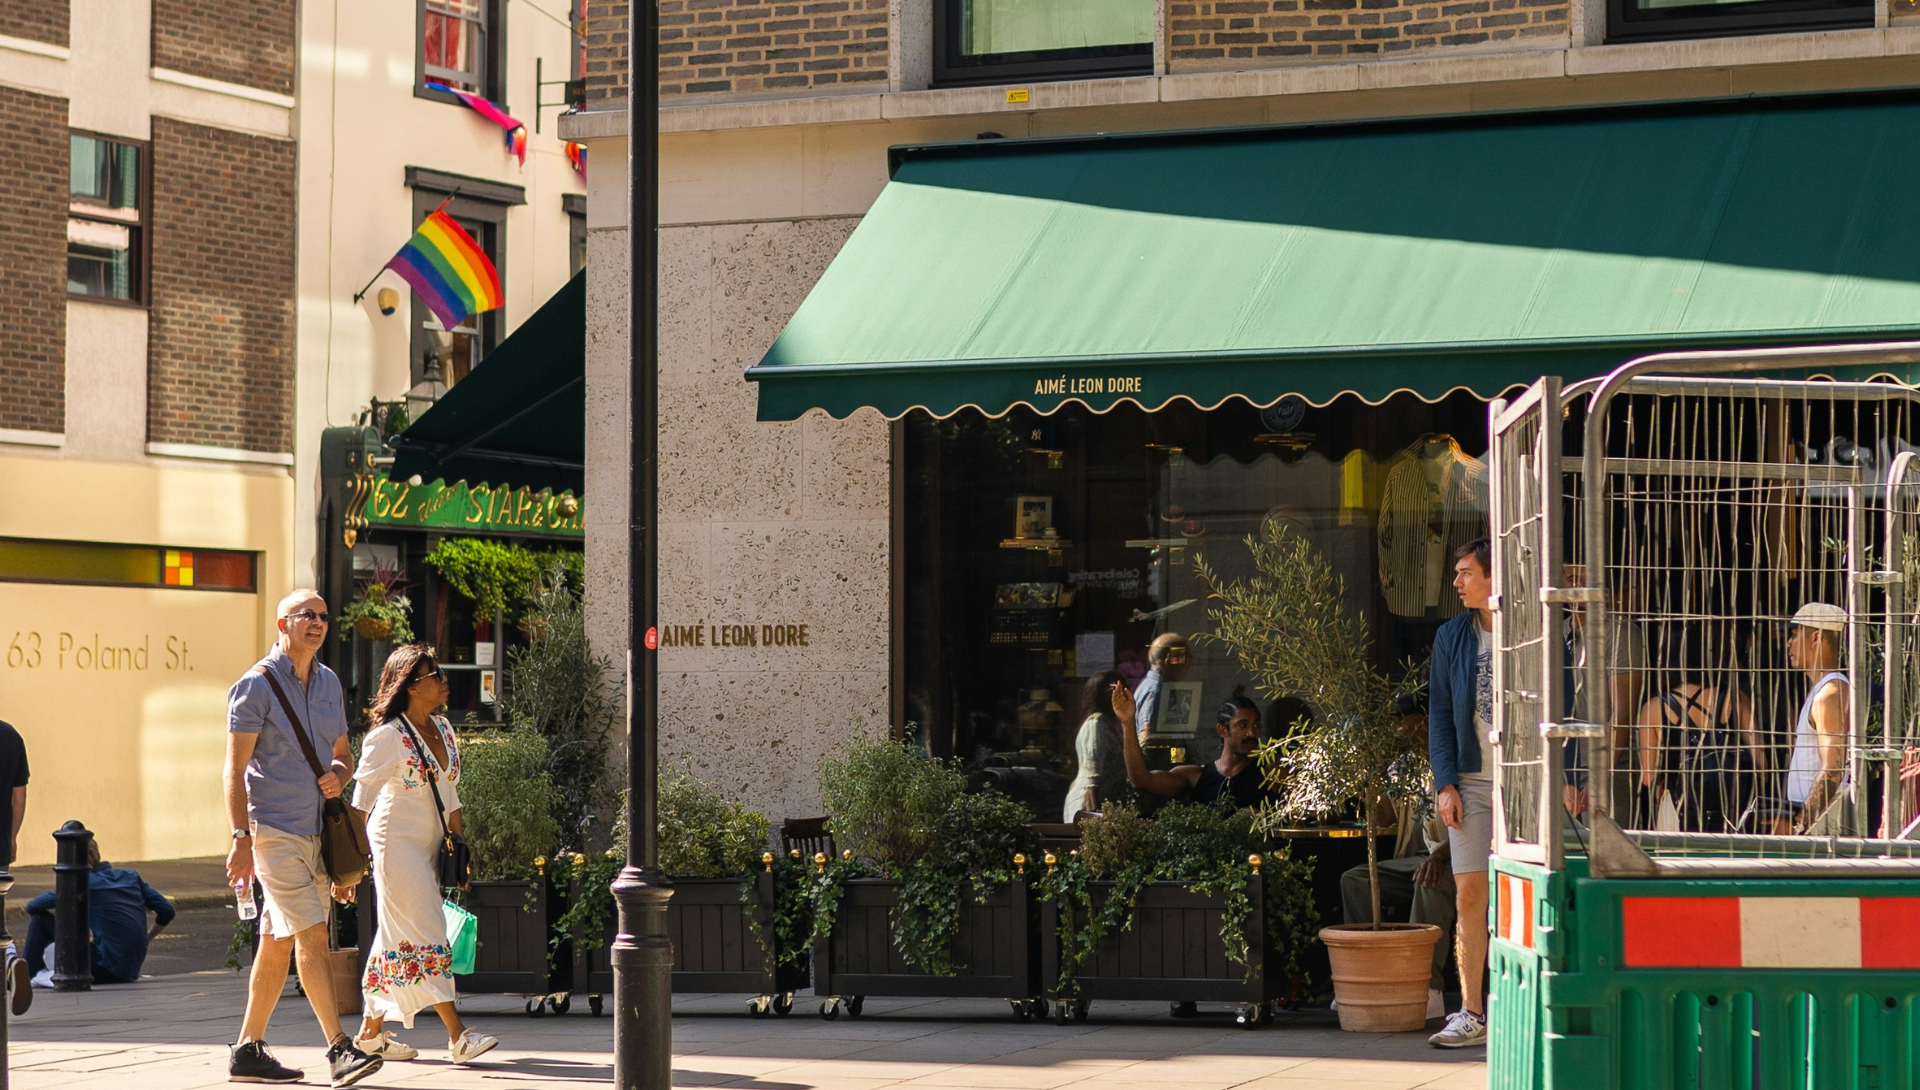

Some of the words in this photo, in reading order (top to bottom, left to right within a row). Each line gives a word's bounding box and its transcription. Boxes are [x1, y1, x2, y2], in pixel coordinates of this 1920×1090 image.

[1035, 374, 1066, 394] AIMÉ
[1070, 378, 1103, 394] LEON
[1108, 377, 1142, 393] DORE
[374, 478, 409, 519] 62
[661, 619, 704, 647] AIMÉ
[711, 625, 757, 647] LEON
[762, 624, 809, 647] DORE
[7, 631, 42, 669] 63
[59, 631, 149, 671] Poland
[165, 635, 193, 671] St.
